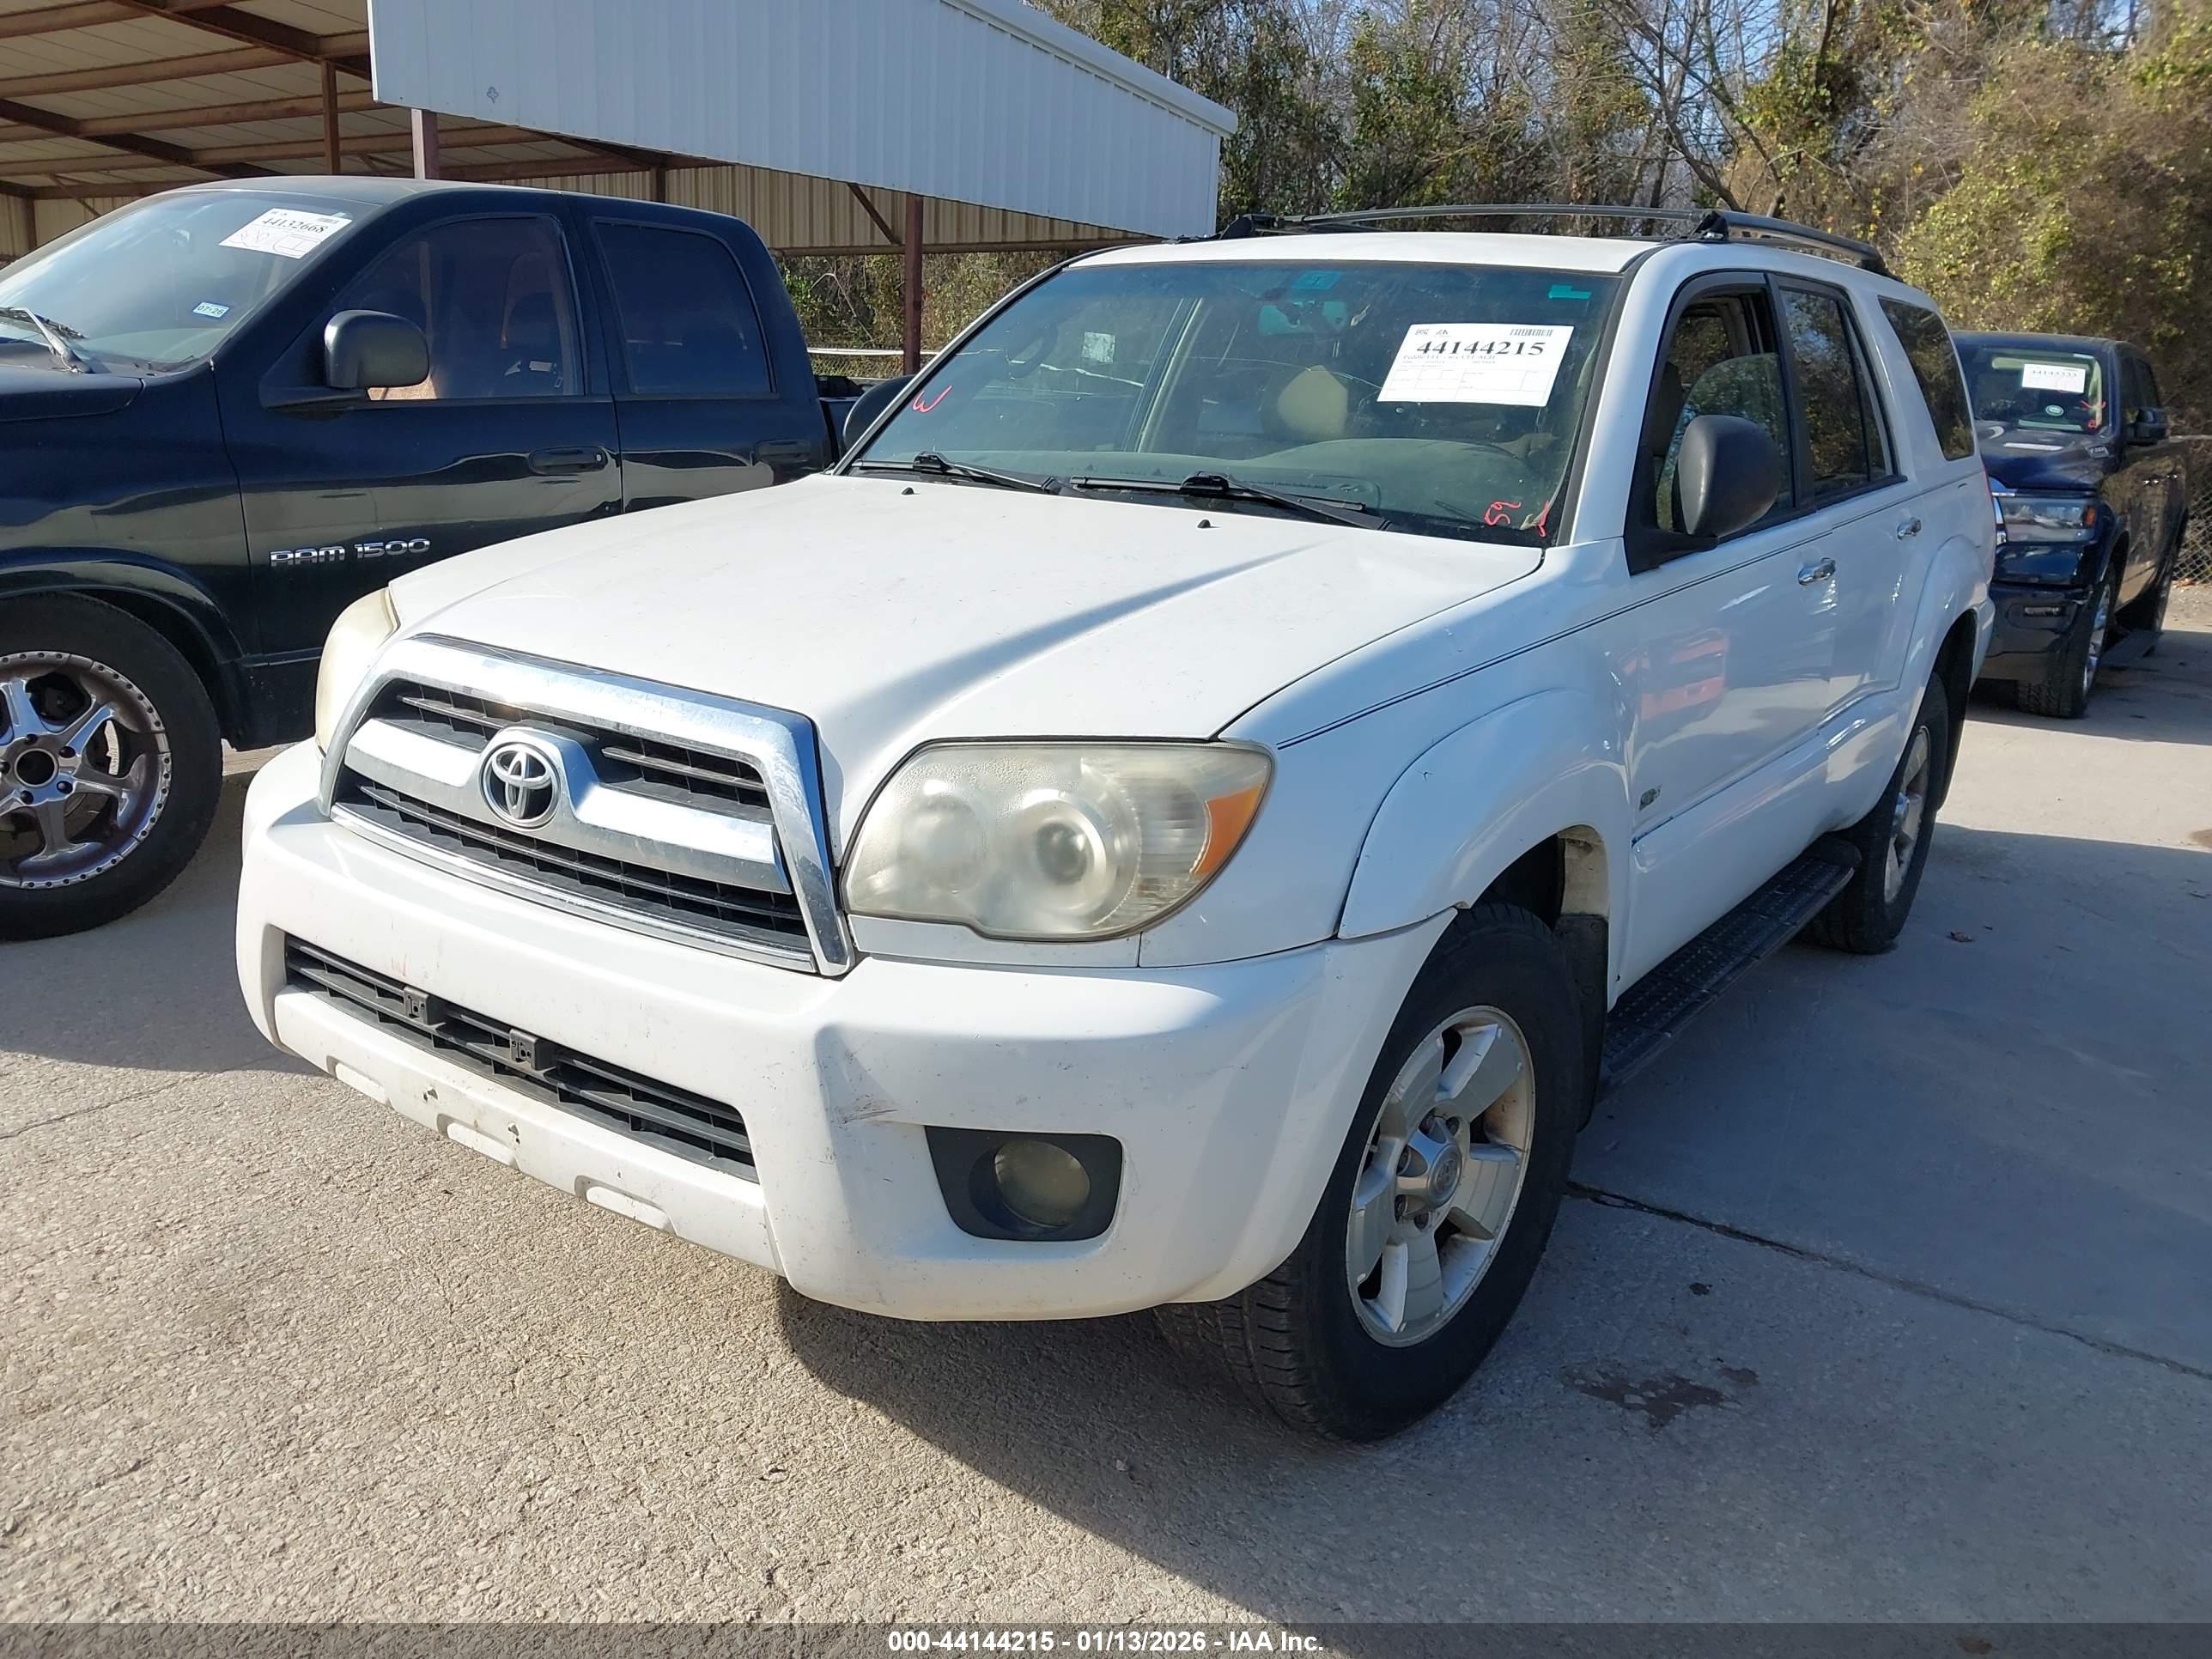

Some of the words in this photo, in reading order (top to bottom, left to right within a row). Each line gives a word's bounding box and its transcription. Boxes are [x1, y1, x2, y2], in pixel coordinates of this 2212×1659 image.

[1416, 340, 1546, 356] 44144215
[270, 544, 345, 567] RAM
[353, 538, 431, 559] 1500
